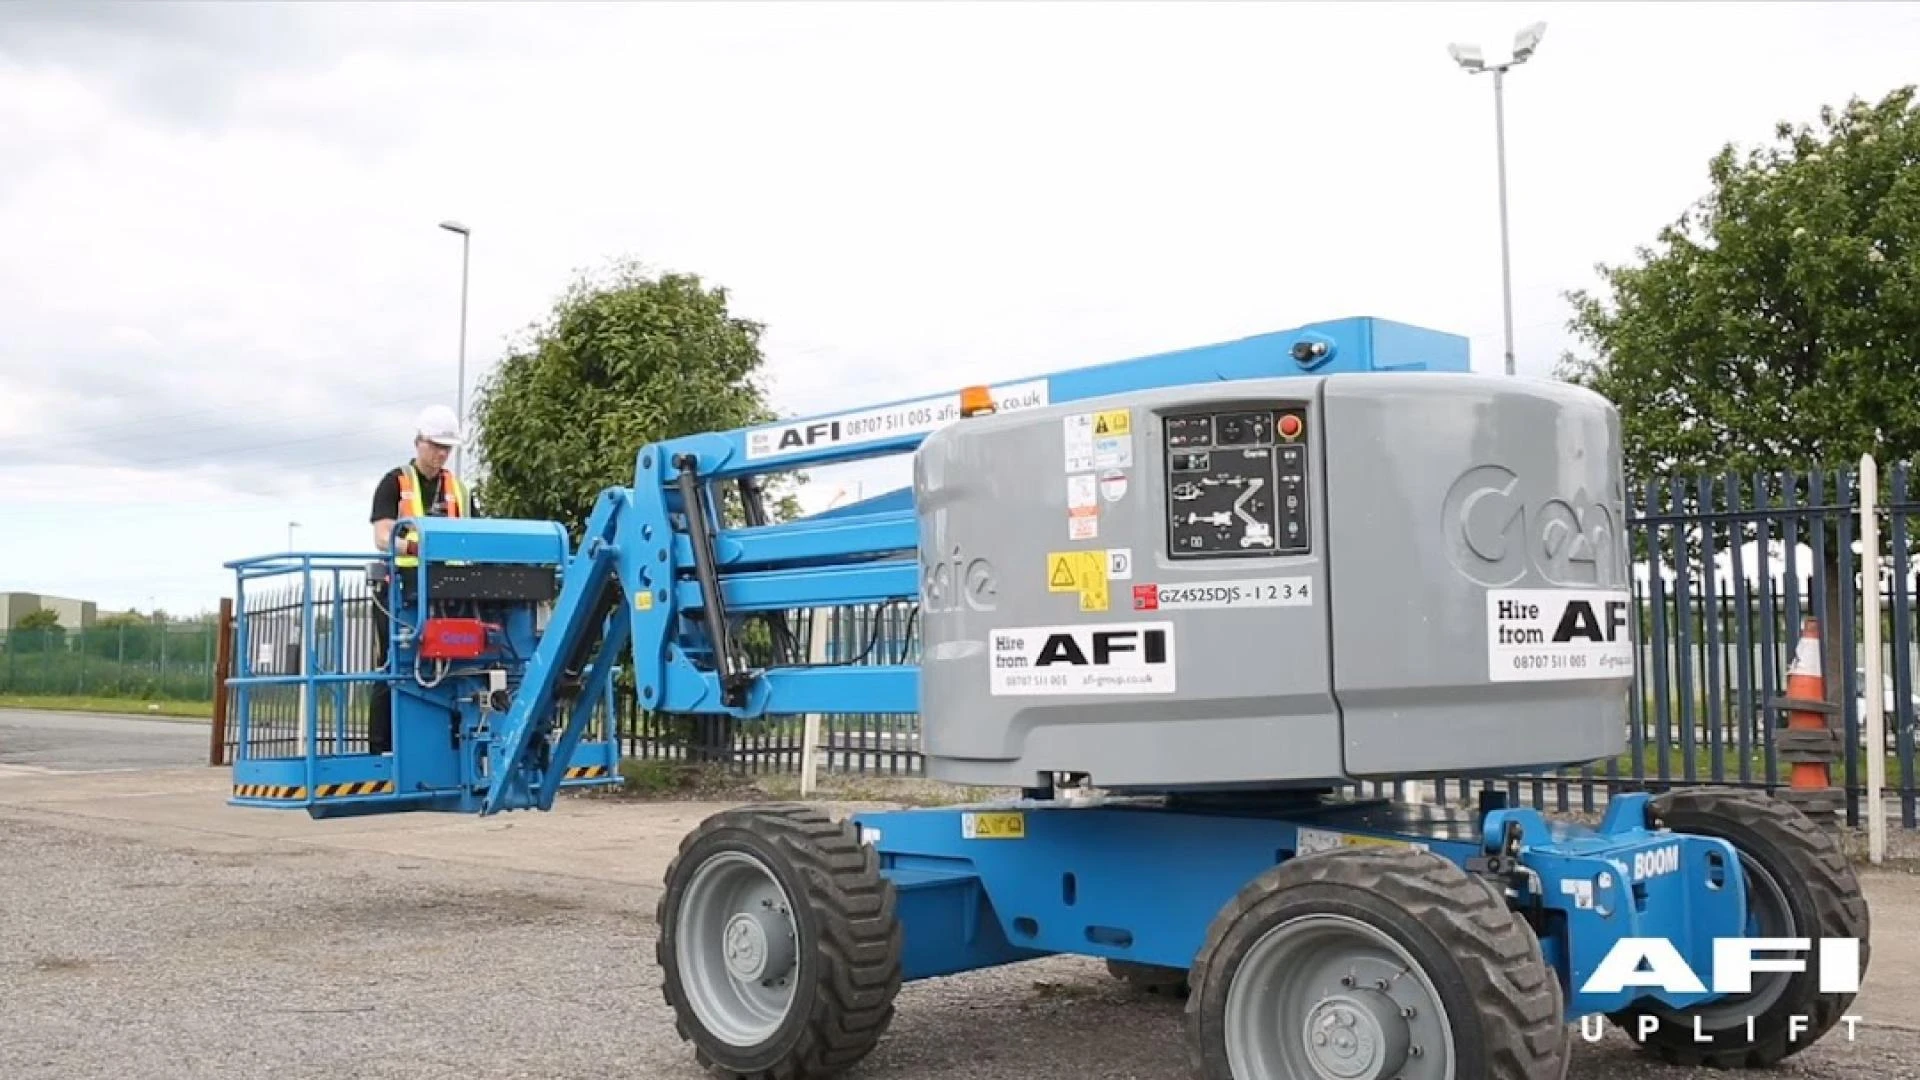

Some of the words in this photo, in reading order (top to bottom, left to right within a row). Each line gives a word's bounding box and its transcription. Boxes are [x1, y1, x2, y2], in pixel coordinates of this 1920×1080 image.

[779, 421, 840, 449] AFI
[847, 416, 883, 436] 08707
[887, 413, 904, 429] 511
[908, 408, 931, 424] 005
[1498, 600, 1539, 619] Hire
[1498, 625, 1543, 643] from
[995, 636, 1025, 651] Hire
[1034, 629, 1166, 667] AFI
[996, 655, 1028, 668] from
[1513, 655, 1547, 668] 08707
[1551, 655, 1566, 668] 511
[1570, 655, 1587, 668] 005
[1633, 844, 1680, 880] BOOM
